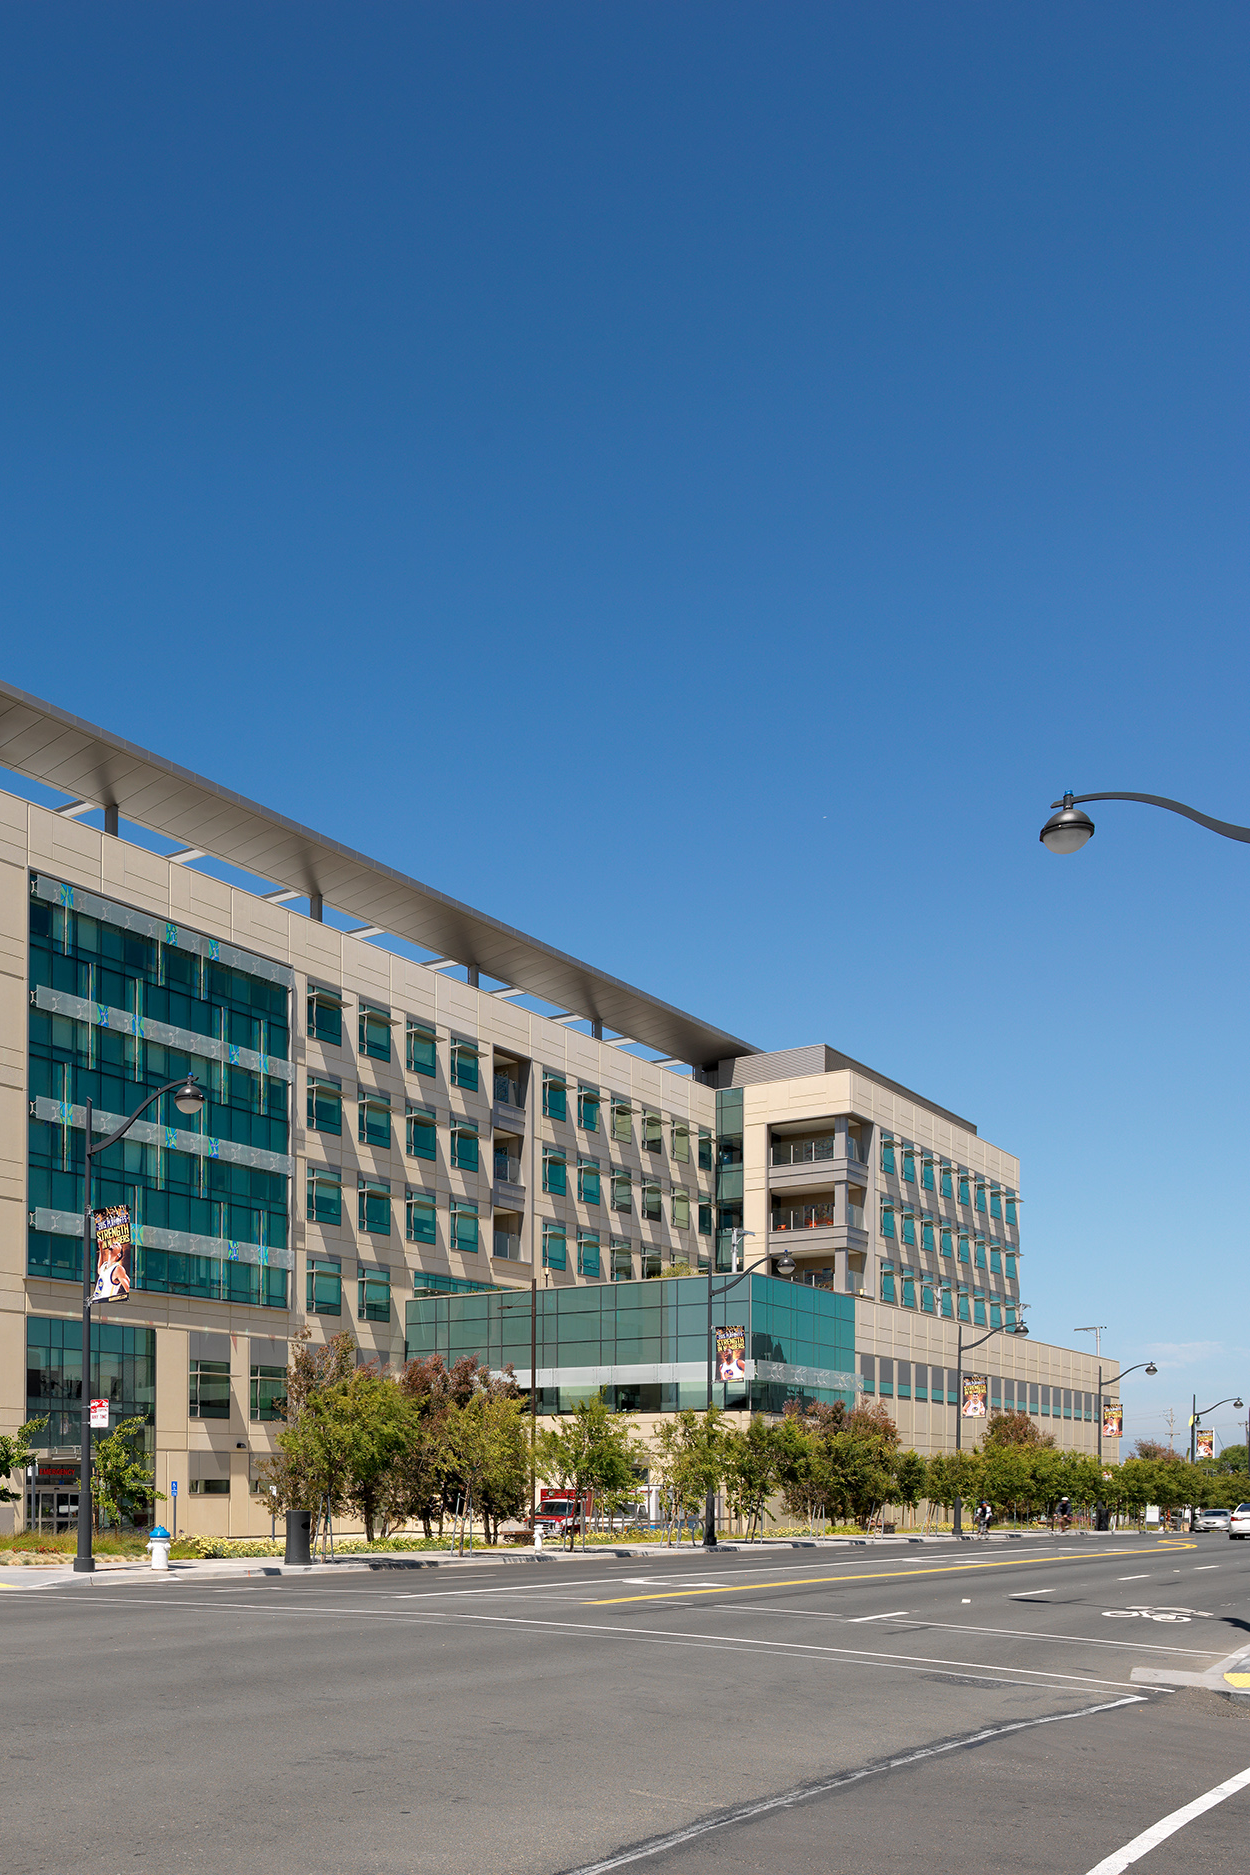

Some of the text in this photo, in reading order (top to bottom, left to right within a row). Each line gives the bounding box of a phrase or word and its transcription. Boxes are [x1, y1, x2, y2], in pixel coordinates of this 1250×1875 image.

[96, 1223, 129, 1241] STRENGTH
[716, 1336, 745, 1347] STRENGTH
[39, 1468, 76, 1476] EMERGENCY
